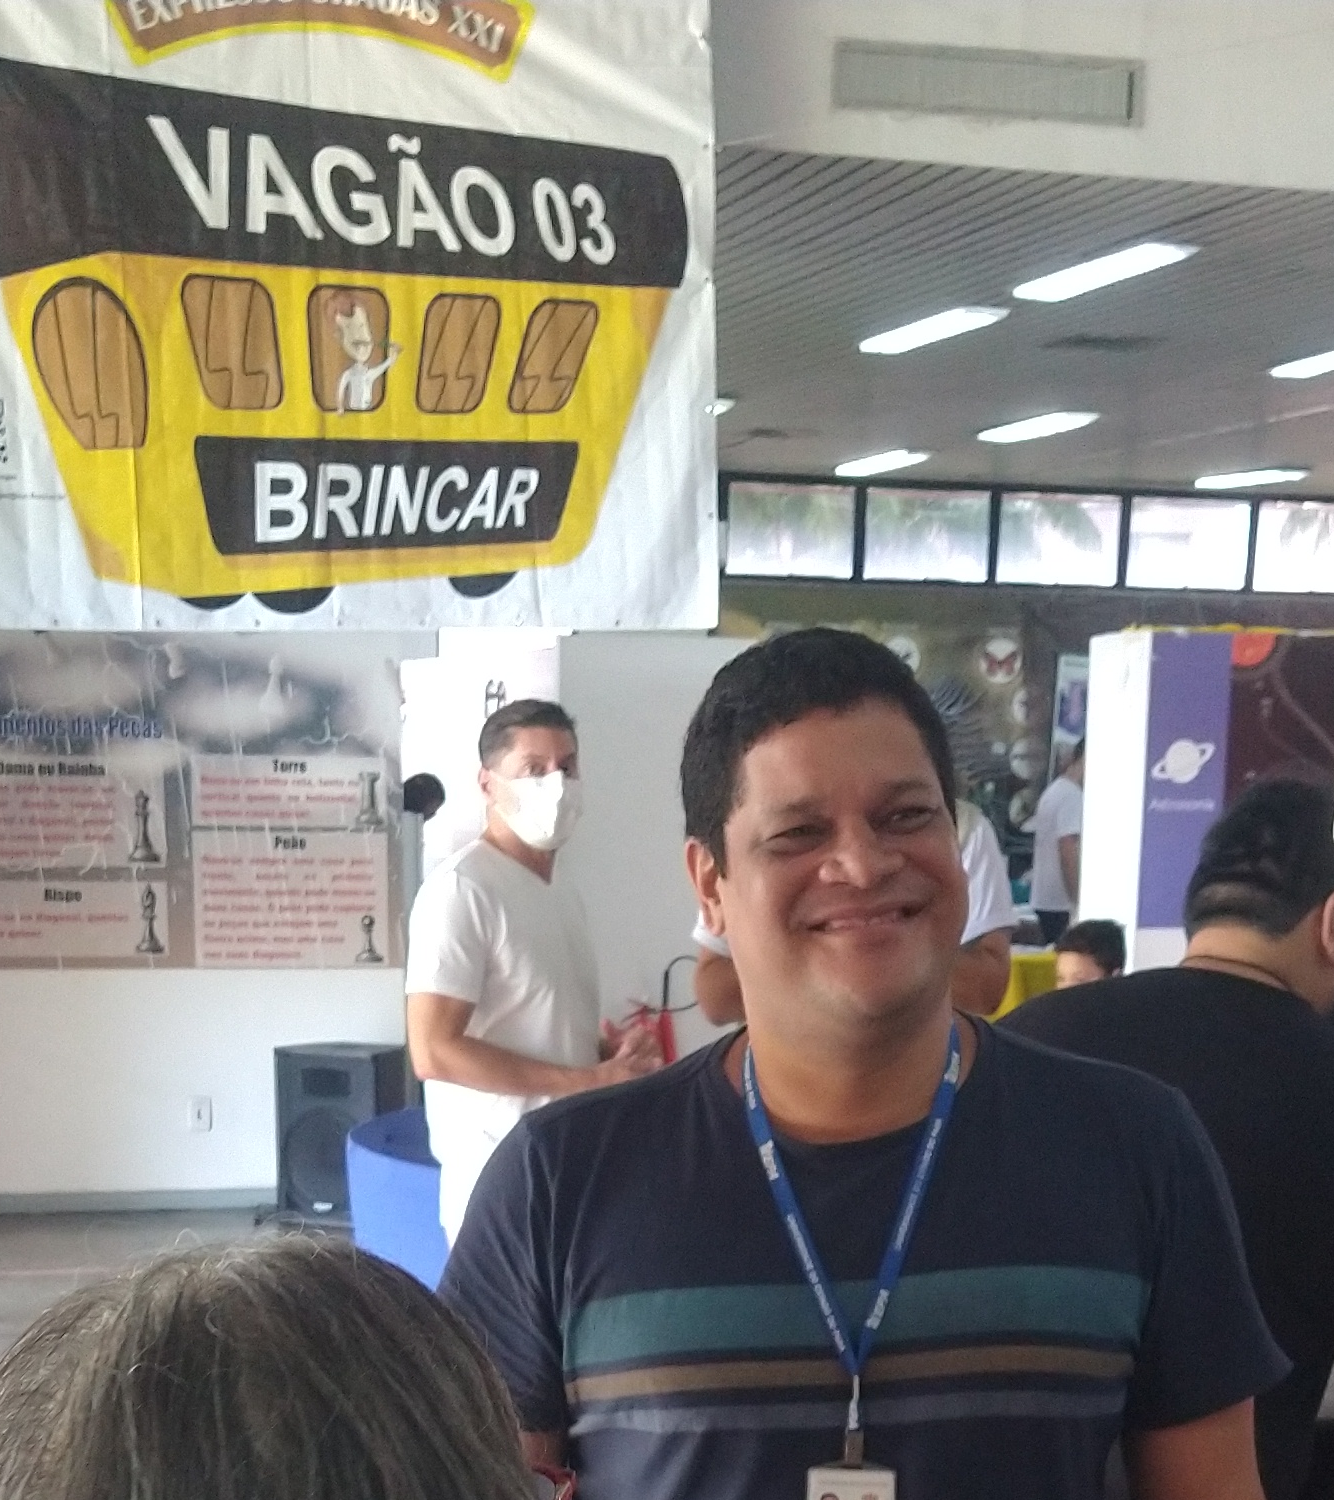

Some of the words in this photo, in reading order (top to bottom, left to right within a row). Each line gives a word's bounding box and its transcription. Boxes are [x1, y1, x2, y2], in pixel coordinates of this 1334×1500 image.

[448, 5, 506, 53] XXI
[147, 115, 516, 257] VAGÃO
[533, 176, 617, 266] 03
[254, 459, 541, 544] BRINCAR
